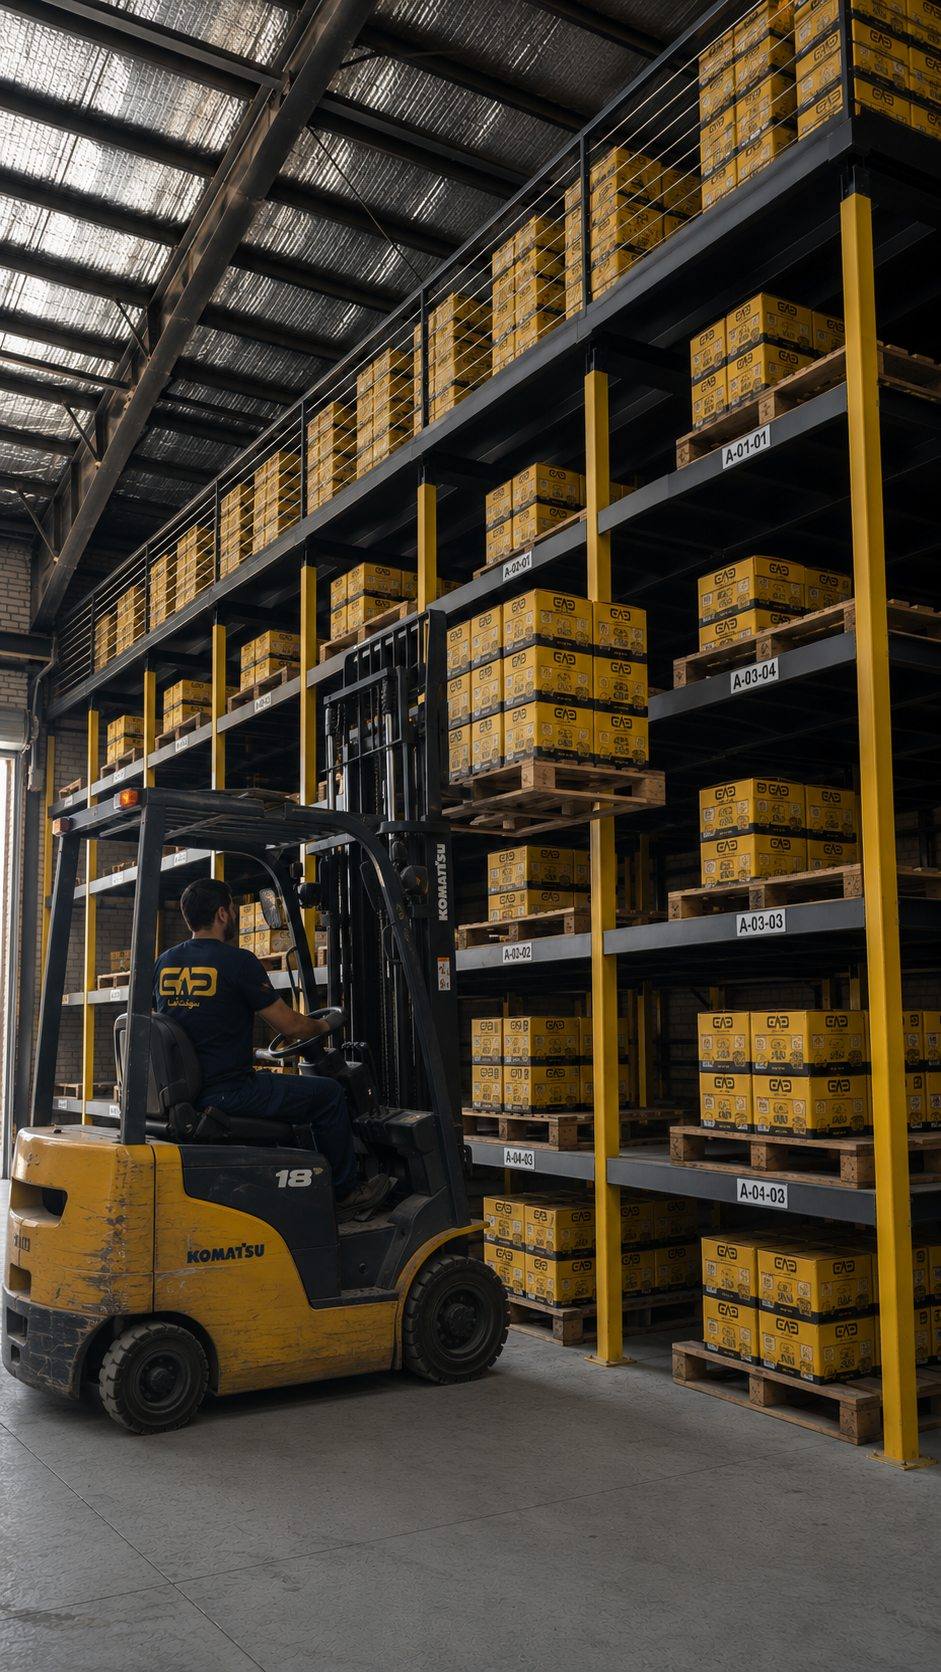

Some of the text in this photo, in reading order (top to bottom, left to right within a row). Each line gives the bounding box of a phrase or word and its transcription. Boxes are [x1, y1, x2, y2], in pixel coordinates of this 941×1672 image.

[726, 431, 768, 465] A-01-01
[733, 663, 776, 690] A-03-04
[435, 843, 448, 921] KOMATSU
[739, 914, 783, 933] A-03-03
[275, 1169, 313, 1188] 18
[187, 1243, 264, 1263] KOMATSU
